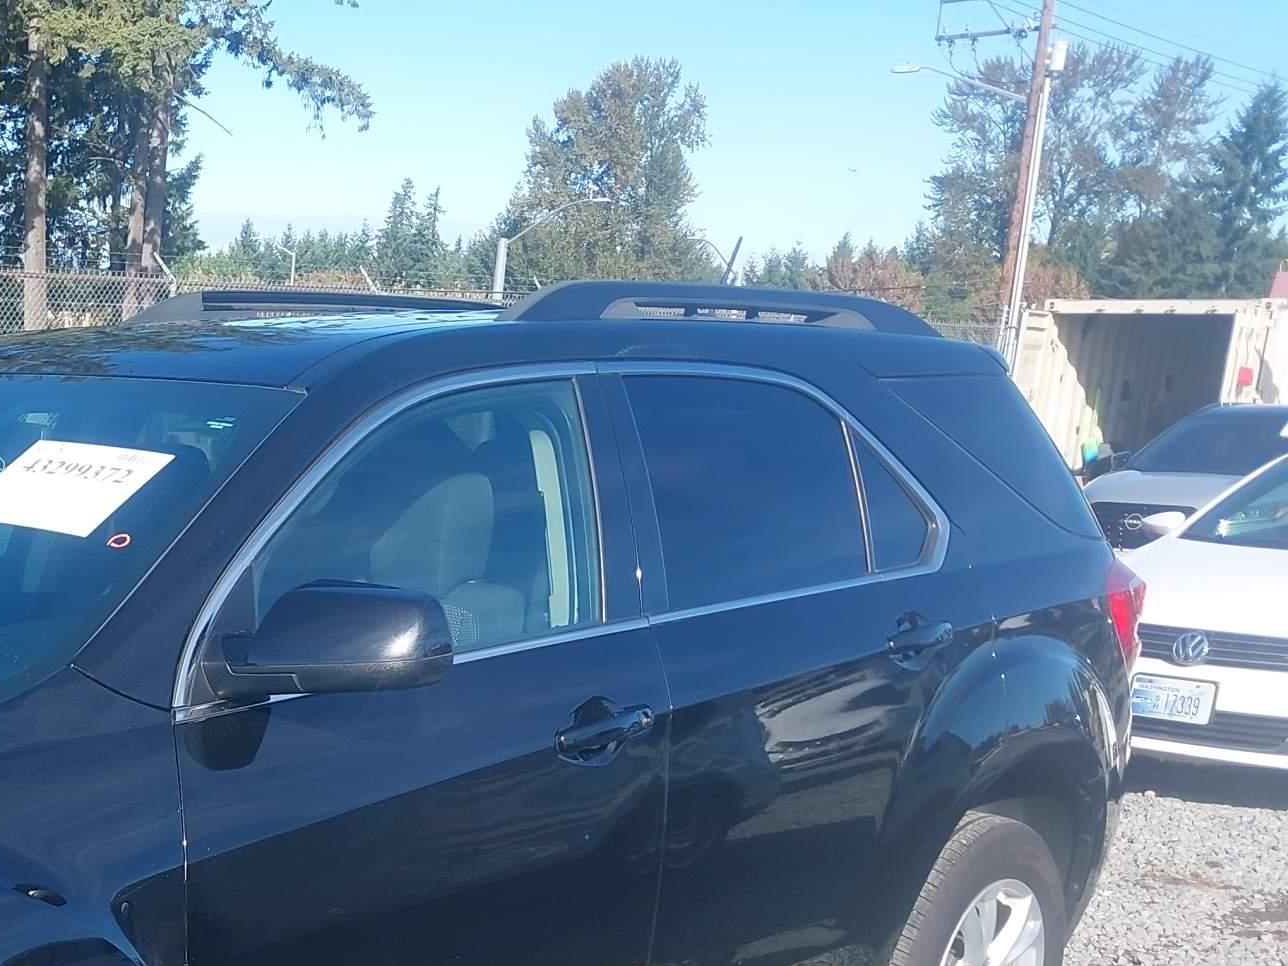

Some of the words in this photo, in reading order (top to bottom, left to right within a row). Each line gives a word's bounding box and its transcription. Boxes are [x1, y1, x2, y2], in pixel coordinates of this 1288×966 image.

[23, 457, 134, 484] 43299372
[1139, 683, 1181, 694] WASHINGTON
[1164, 693, 1201, 716] 17339
